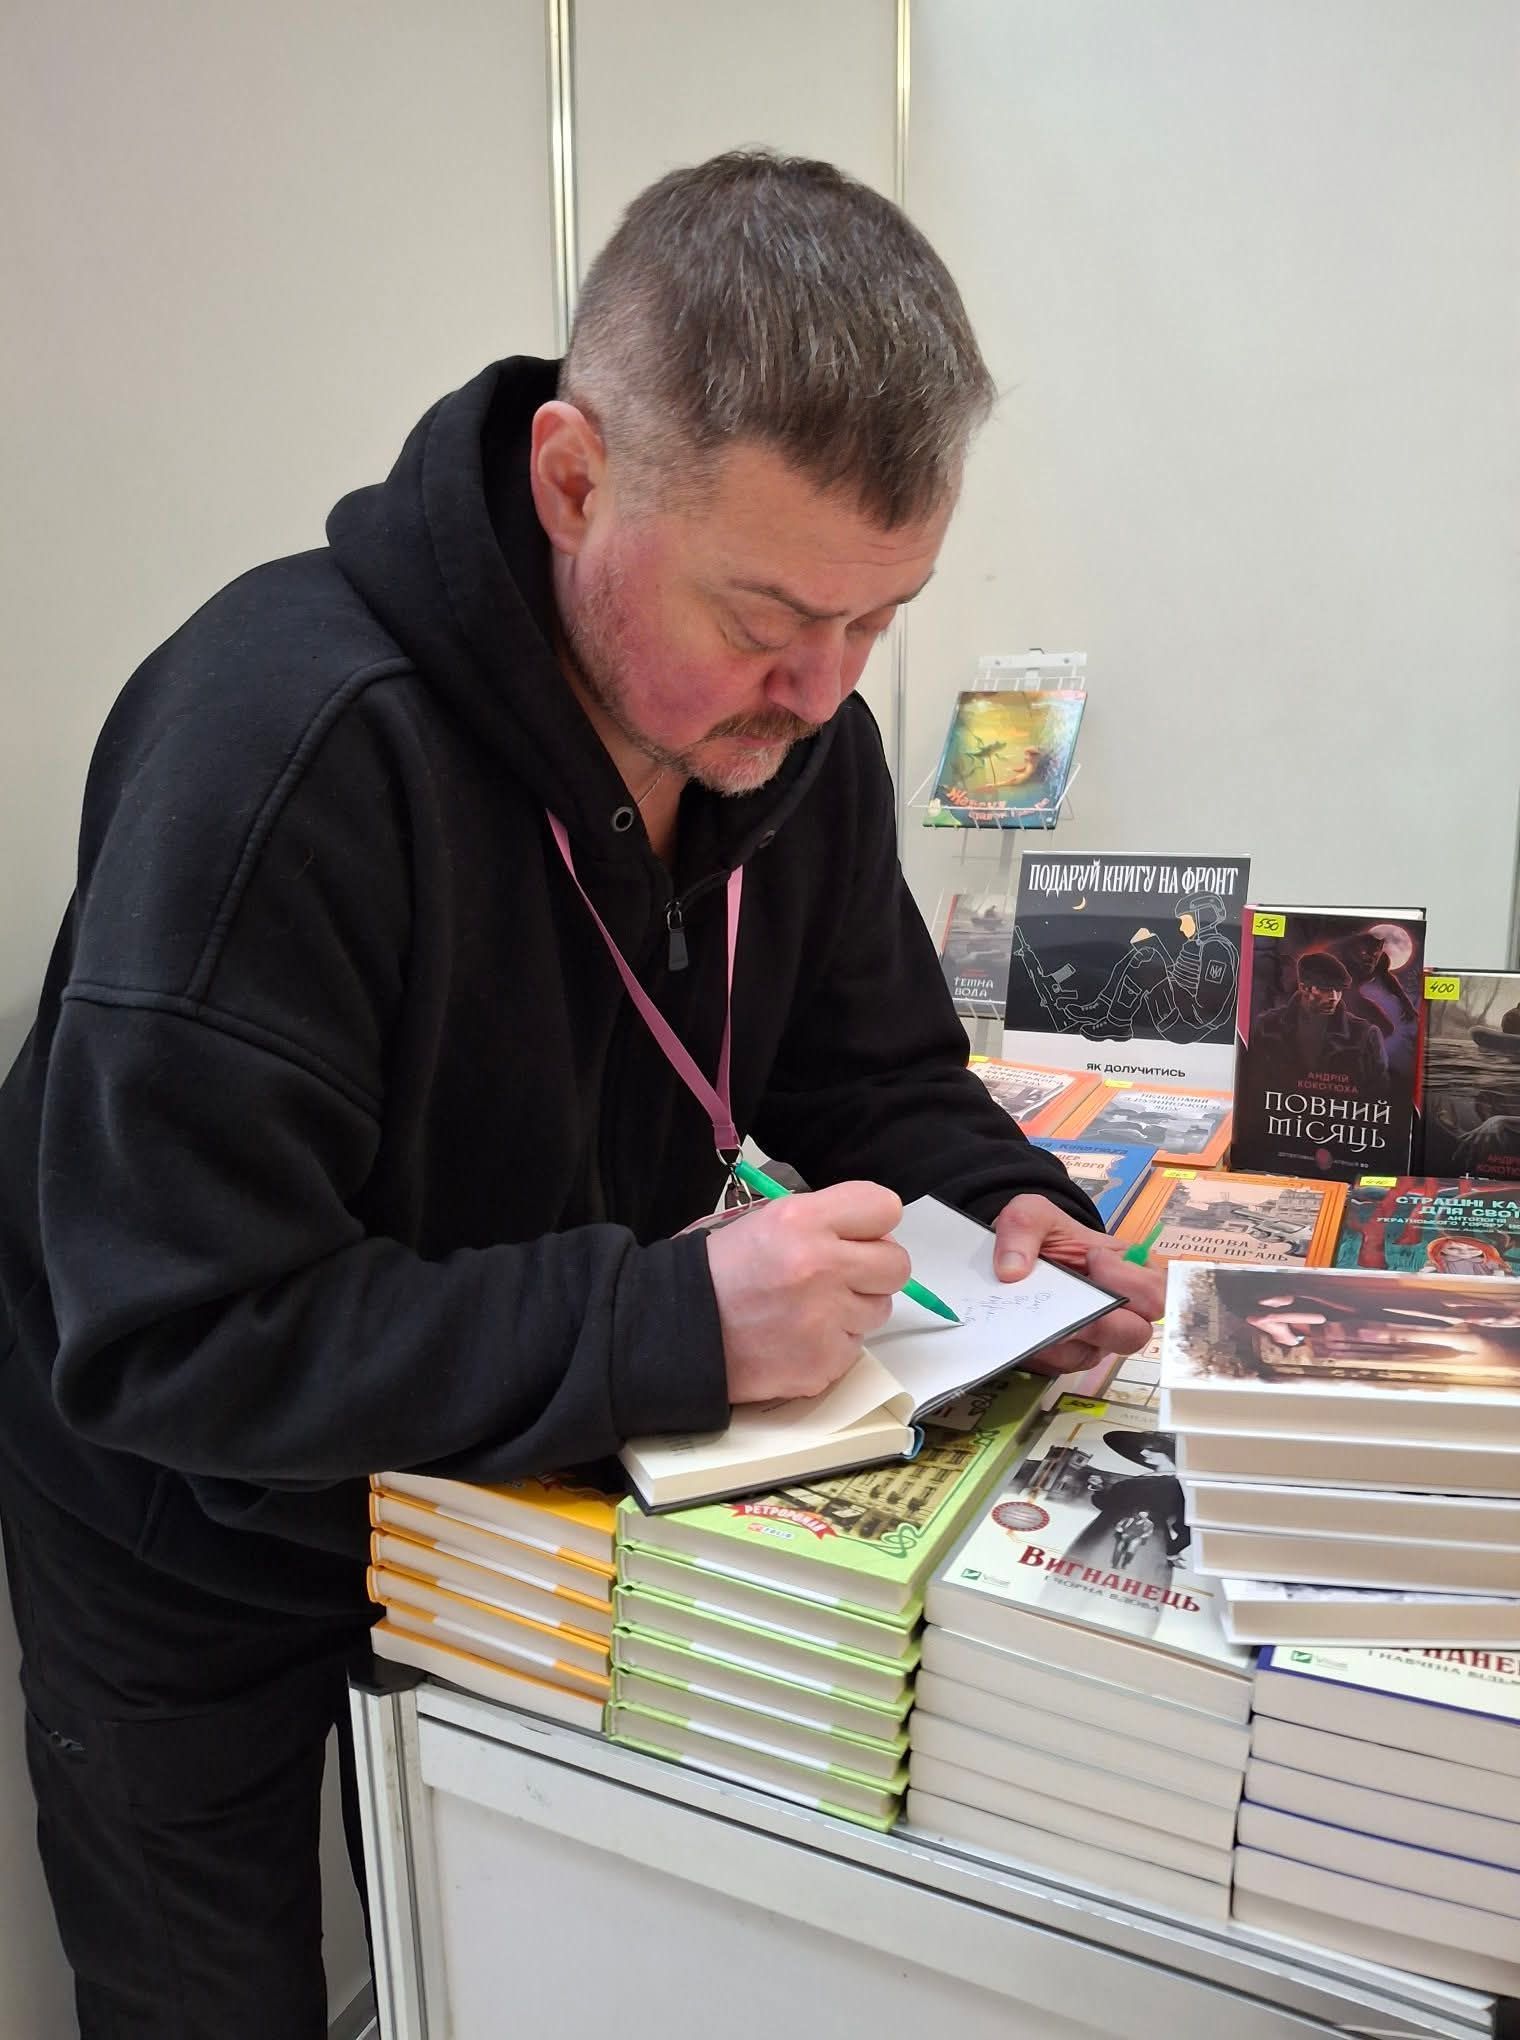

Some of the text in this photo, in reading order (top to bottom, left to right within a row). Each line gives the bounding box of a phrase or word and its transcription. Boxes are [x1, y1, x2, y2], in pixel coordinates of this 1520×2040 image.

[1028, 859, 1239, 898] ПОДАРУЙ КНИГУ НА ФРОНТ
[1255, 918, 1279, 931] 550
[954, 987, 987, 998] ВОДА
[1429, 983, 1455, 993] 400
[1086, 1063, 1186, 1078] ЯК ДОЛУЧИТИСЬ
[1307, 1072, 1349, 1083] АНДРІЙ
[1297, 1081, 1358, 1094] КОКОТЮХА
[1265, 1090, 1392, 1125] ПОВНИЙ
[1267, 1115, 1386, 1153] МІСЯЦЬ
[1395, 1197, 1520, 1211] СТРАШНІ КА
[1419, 1206, 1520, 1219] ДЛЯ СВОЇ
[1178, 1234, 1269, 1250] ГОЛОВА З
[1159, 1241, 1290, 1262] ПЛОЩІ ПІГАЛЬ
